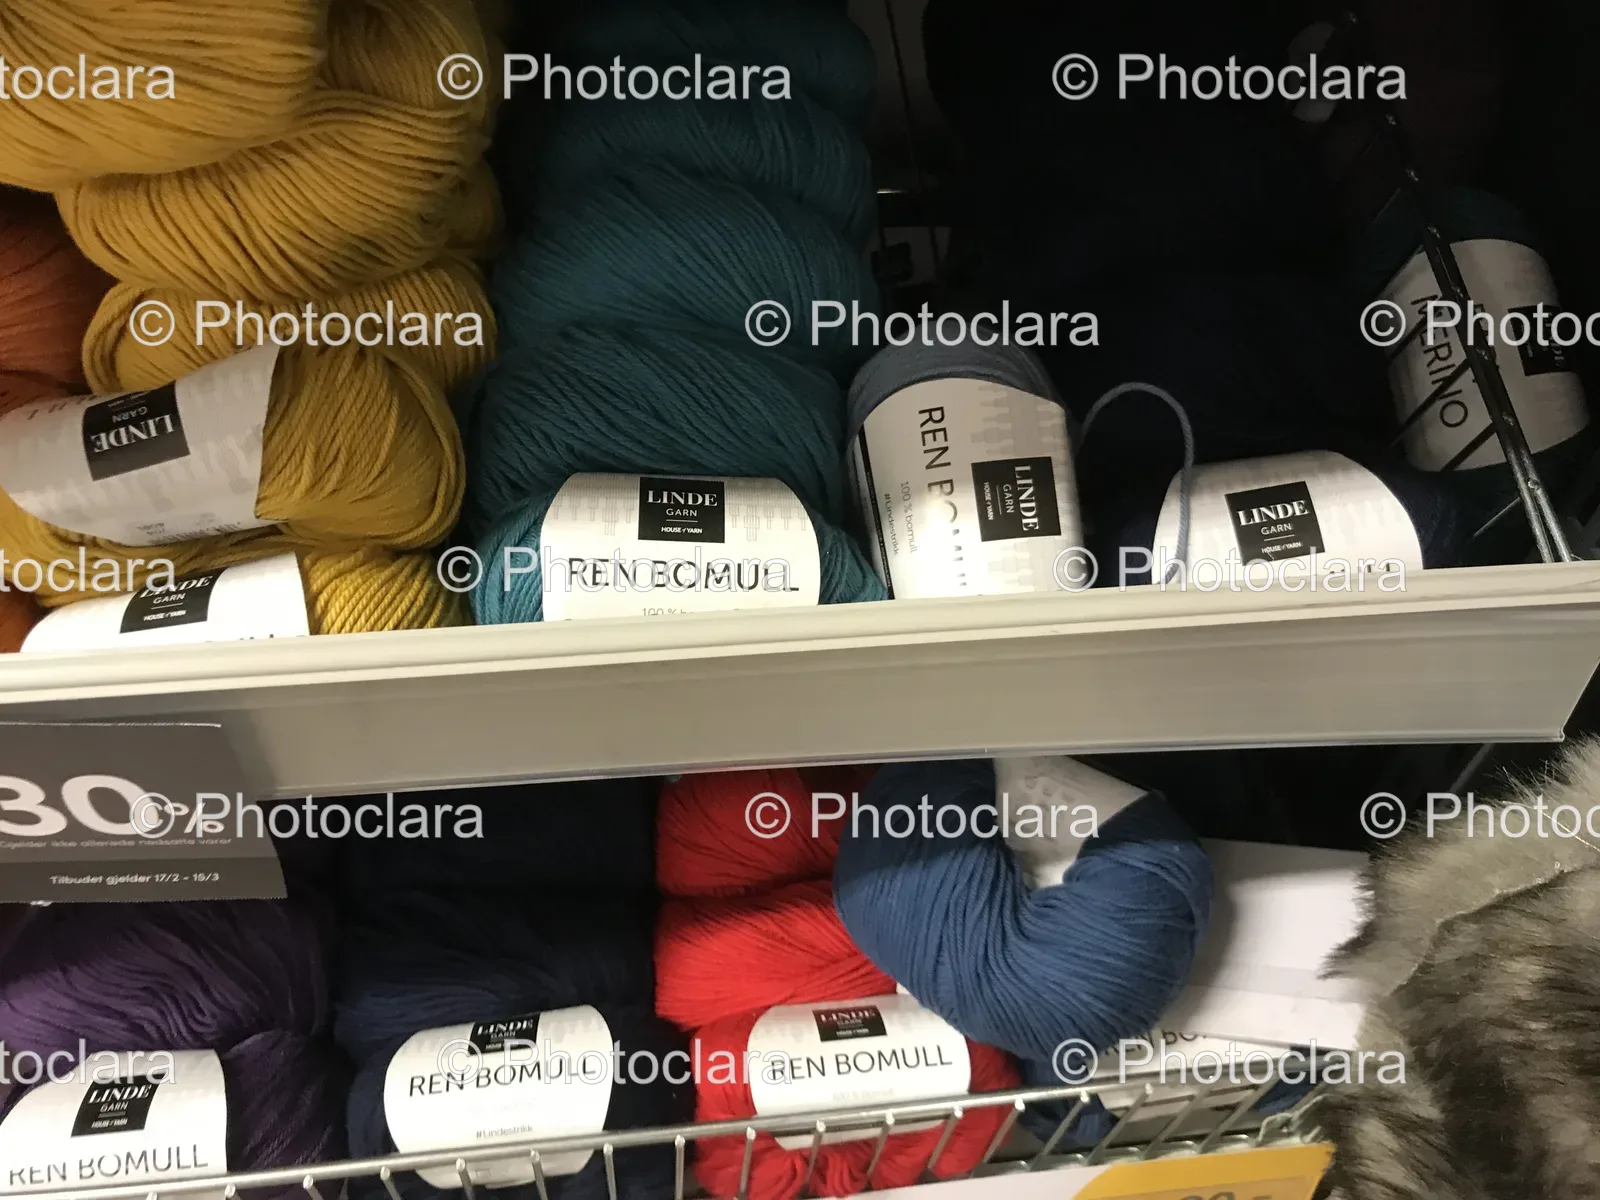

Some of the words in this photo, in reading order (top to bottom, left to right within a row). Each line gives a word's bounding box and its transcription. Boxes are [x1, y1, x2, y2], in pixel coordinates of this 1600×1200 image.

[1410, 294, 1469, 428] MERINO
[112, 405, 148, 423] GARN
[90, 413, 176, 453] LINDE
[918, 405, 952, 471] REN
[647, 489, 718, 507] LINDE
[900, 480, 912, 501] 100
[983, 481, 992, 501] HOUSE
[1002, 483, 1015, 514] GARN
[1014, 464, 1040, 532] LINDE
[665, 507, 698, 517] GARN
[903, 502, 913, 513] %
[986, 504, 994, 521] YARN
[1236, 500, 1310, 526] LINDE
[884, 492, 899, 556] #Lindestrikk
[1260, 522, 1294, 535] GARN
[1261, 544, 1282, 554] HOUSE
[1285, 541, 1303, 549] YARN
[568, 557, 638, 588] REN
[654, 559, 799, 591] BOMULL
[153, 592, 187, 605] GARN
[50, 873, 103, 885] Tilbudet
[106, 873, 151, 885] gjelder
[154, 873, 179, 883] 17/2
[476, 1018, 534, 1036] LINDE
[771, 1055, 826, 1081] REN
[835, 1044, 953, 1076] BOMULL
[409, 1072, 465, 1097] REN
[475, 1056, 597, 1089] BOMULL
[88, 1084, 152, 1104] LINDE
[99, 1101, 129, 1113] GARN
[8, 1161, 68, 1186] REN
[78, 1144, 209, 1181] BOMULL
